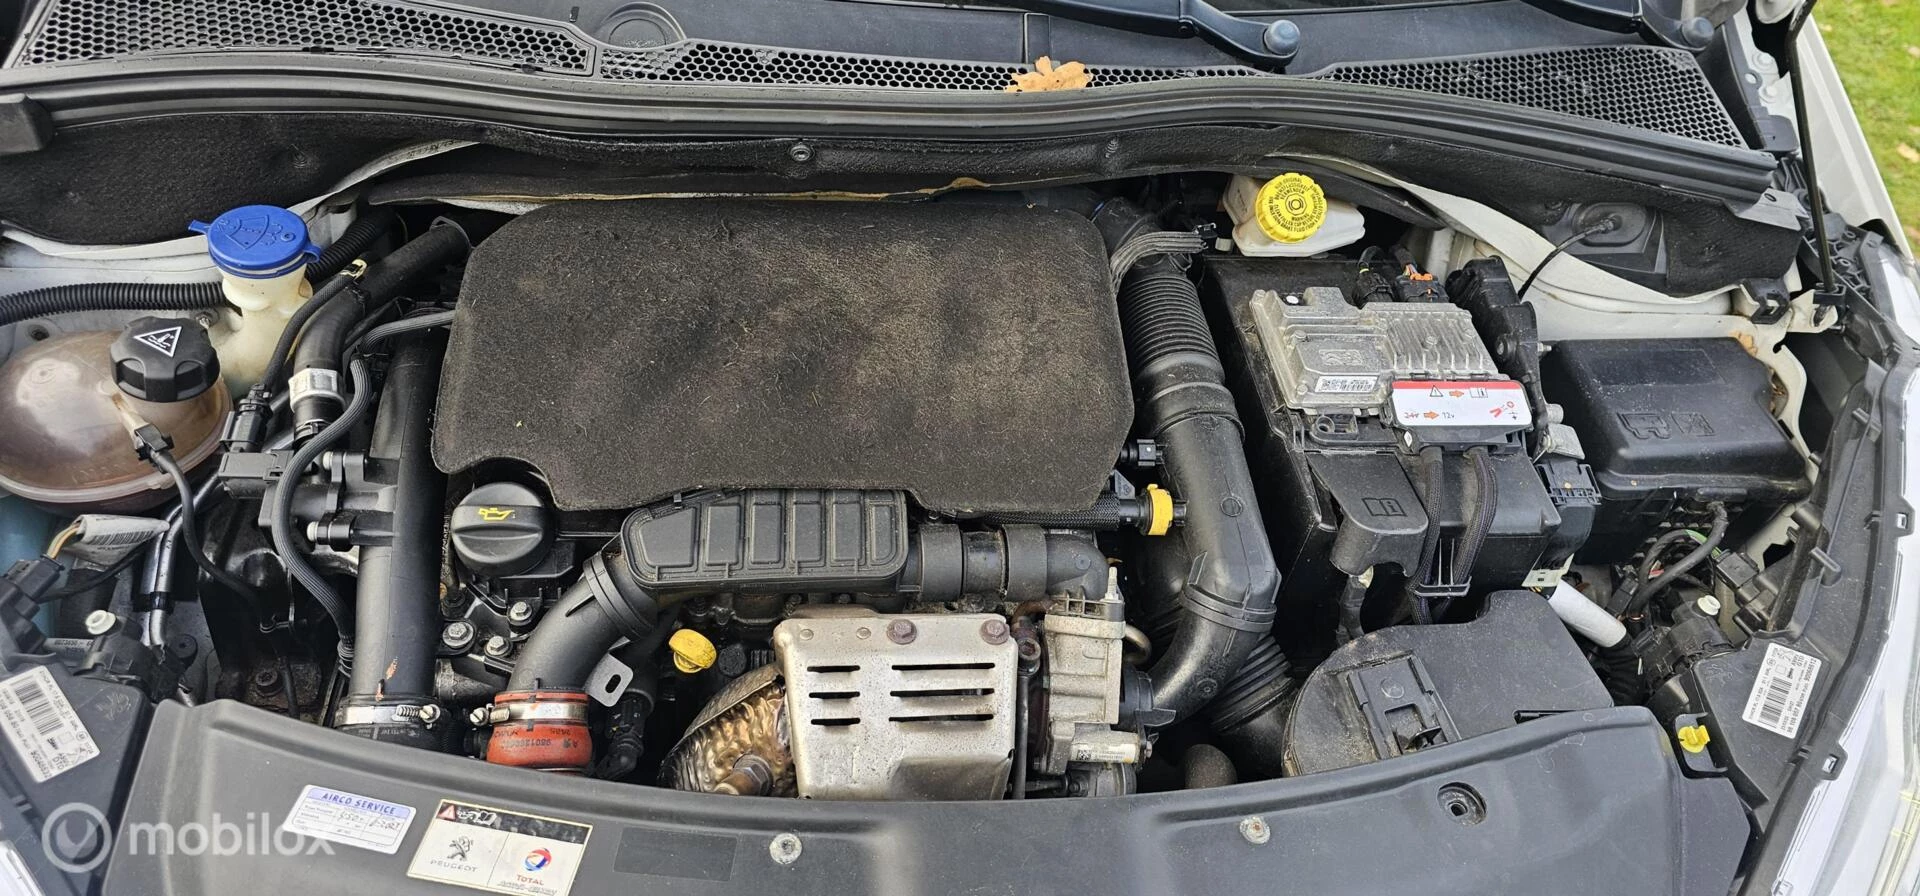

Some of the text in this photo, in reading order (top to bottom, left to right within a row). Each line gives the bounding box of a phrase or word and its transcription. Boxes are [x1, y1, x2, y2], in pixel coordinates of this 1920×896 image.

[321, 793, 397, 815] AIRCO SERVICE
[429, 860, 478, 873] PEUGEOT
[516, 874, 545, 886] TOTAL
